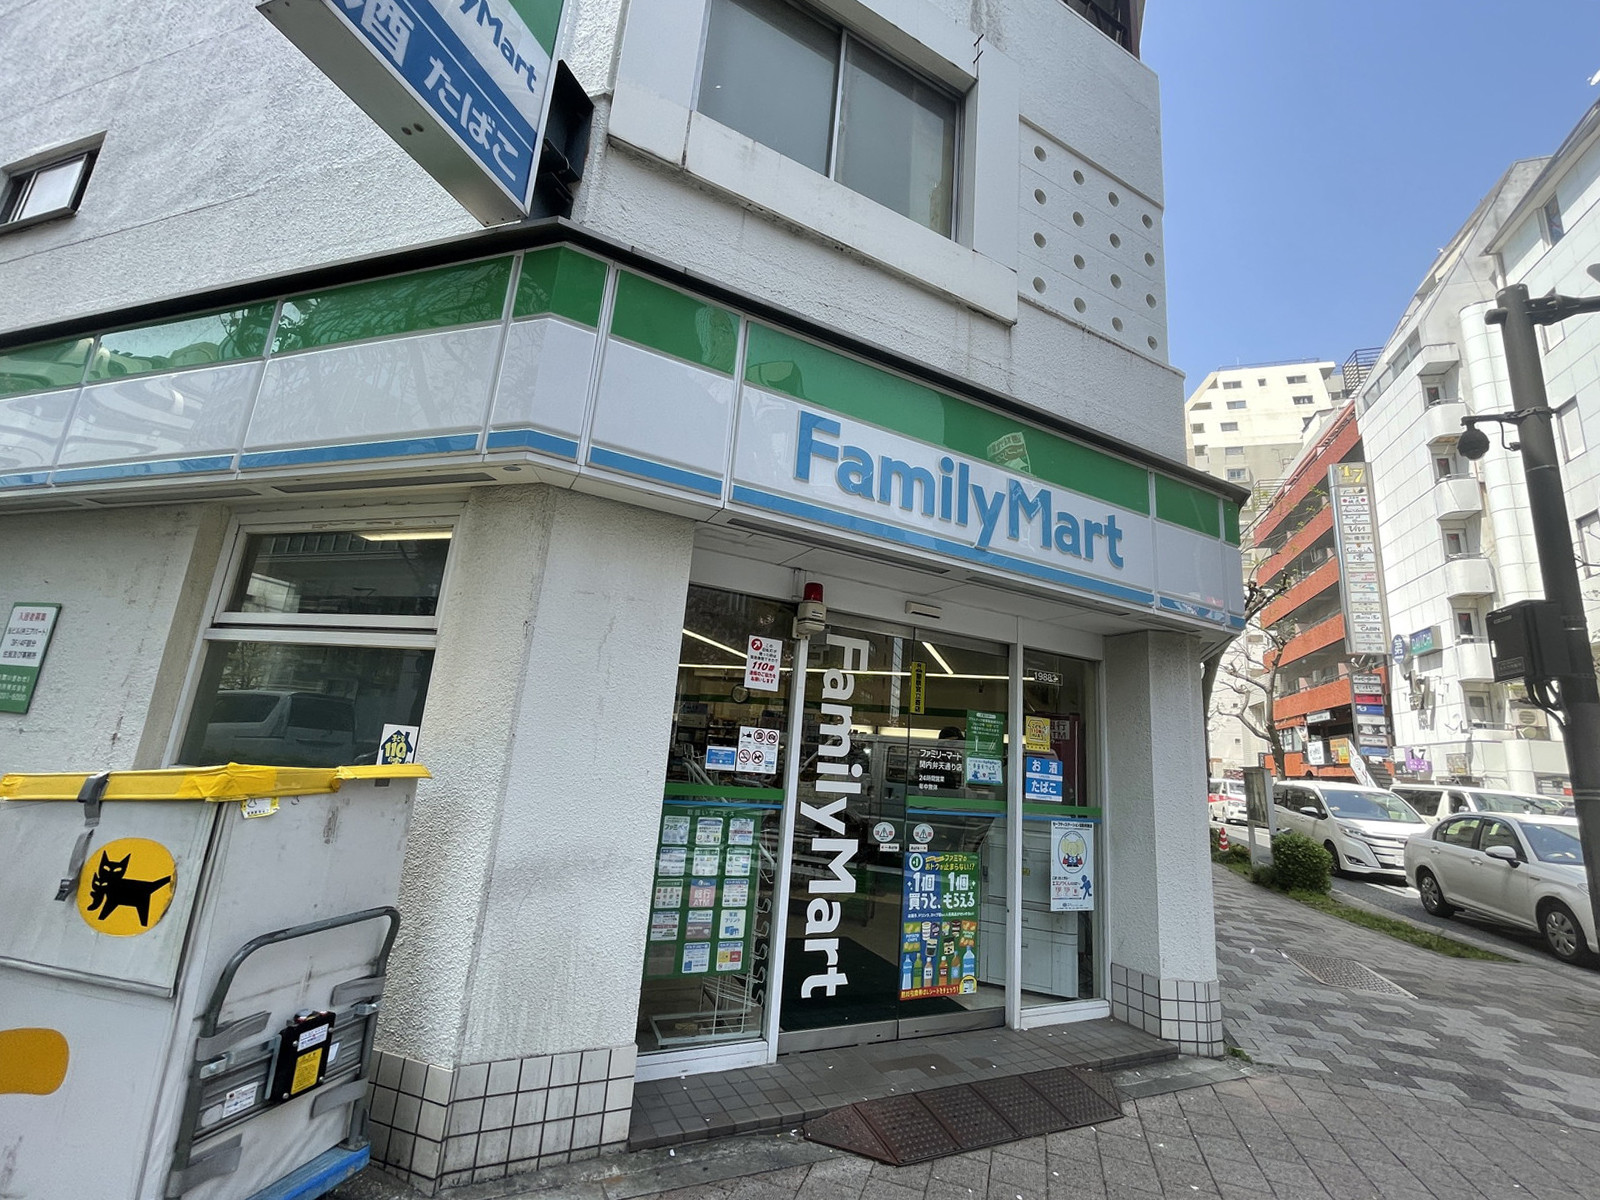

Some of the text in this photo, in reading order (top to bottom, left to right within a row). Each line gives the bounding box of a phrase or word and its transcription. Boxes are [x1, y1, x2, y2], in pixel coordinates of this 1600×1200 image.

[424, 56, 519, 181] たばこ
[1338, 465, 1365, 483] 17
[793, 410, 1124, 569] FamilyMart
[752, 661, 775, 672] 110番
[385, 742, 407, 758] 110
[920, 749, 962, 760] ファミリーマート
[1409, 749, 1426, 759] 17
[919, 759, 962, 771] 関内弁天通り店
[1032, 760, 1058, 774] お酒
[919, 775, 945, 783] 24時間営業
[1031, 780, 1057, 794] たばこ
[800, 633, 870, 999] FamilyMart
[913, 872, 969, 892] 1個 1個
[693, 899, 711, 907] ATM
[943, 892, 975, 909] もらえる
